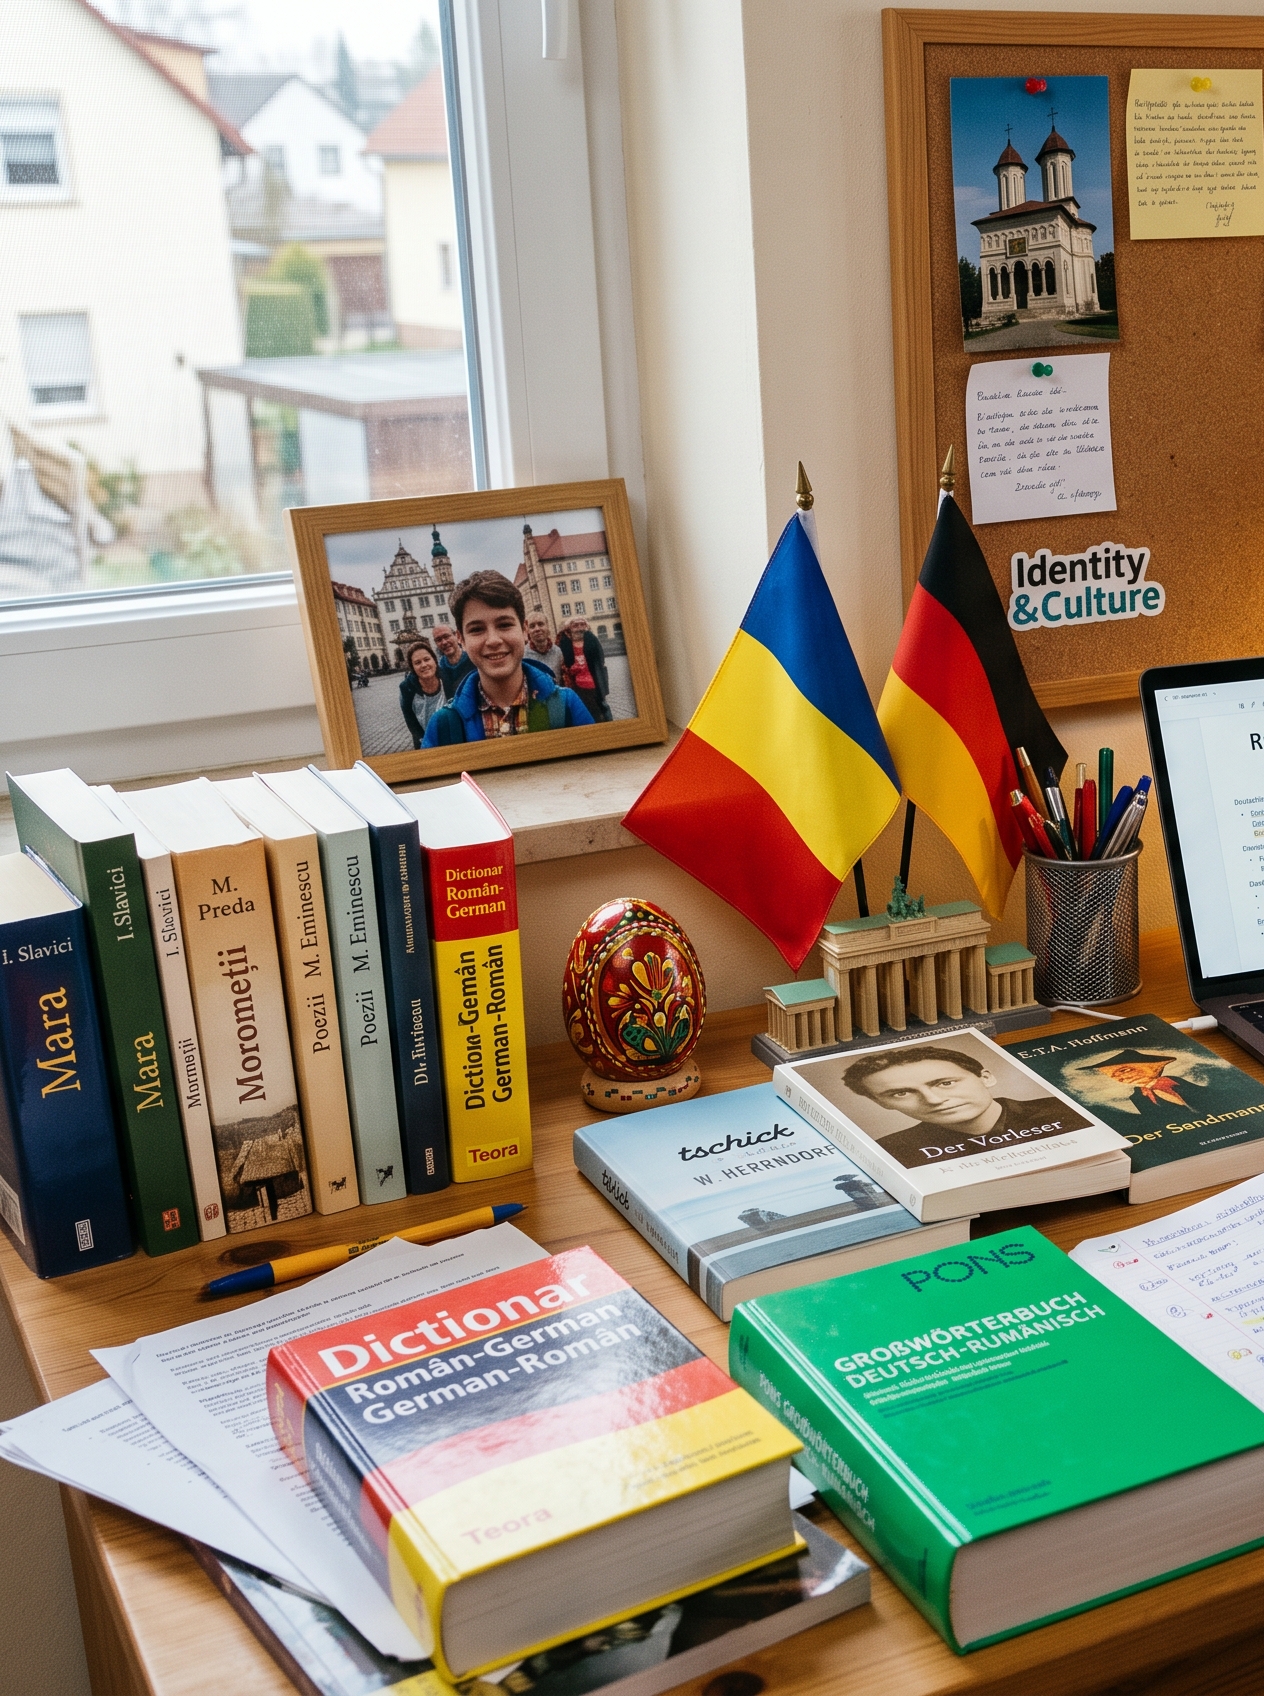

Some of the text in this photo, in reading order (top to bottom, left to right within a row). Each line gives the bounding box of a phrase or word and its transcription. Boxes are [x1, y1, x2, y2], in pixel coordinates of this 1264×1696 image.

[1017, 547, 1146, 588] Identity
[211, 876, 238, 895] M.
[445, 865, 504, 882] Dictionar
[446, 883, 504, 901] Român-
[198, 897, 256, 921] Preda
[446, 900, 506, 919] German
[18, 937, 73, 963] Slavici
[296, 860, 331, 1054] Poezii M. Eminescu
[346, 855, 378, 1048] Poezii M. Eminescu
[37, 986, 81, 1099] Mara
[217, 945, 266, 1105] Moromeții
[482, 944, 513, 1103] German-Român
[133, 1031, 164, 1113] Mara
[1017, 1044, 1067, 1059] E.T.A.
[468, 1143, 518, 1164] Teora
[678, 1123, 795, 1162] tschick
[919, 1143, 966, 1159] Der
[967, 1120, 1063, 1147] Vorleser
[1123, 1130, 1162, 1145] Der
[722, 1144, 837, 1180] HERRNDORF
[901, 1243, 1036, 1293] PONS
[318, 1271, 594, 1378] Dictionar
[345, 1300, 624, 1406] Român-German
[847, 1303, 1106, 1390] DEUTSCH-RUMÄNISCH
[361, 1317, 643, 1427] German-Român
[461, 1504, 553, 1549] Teora
